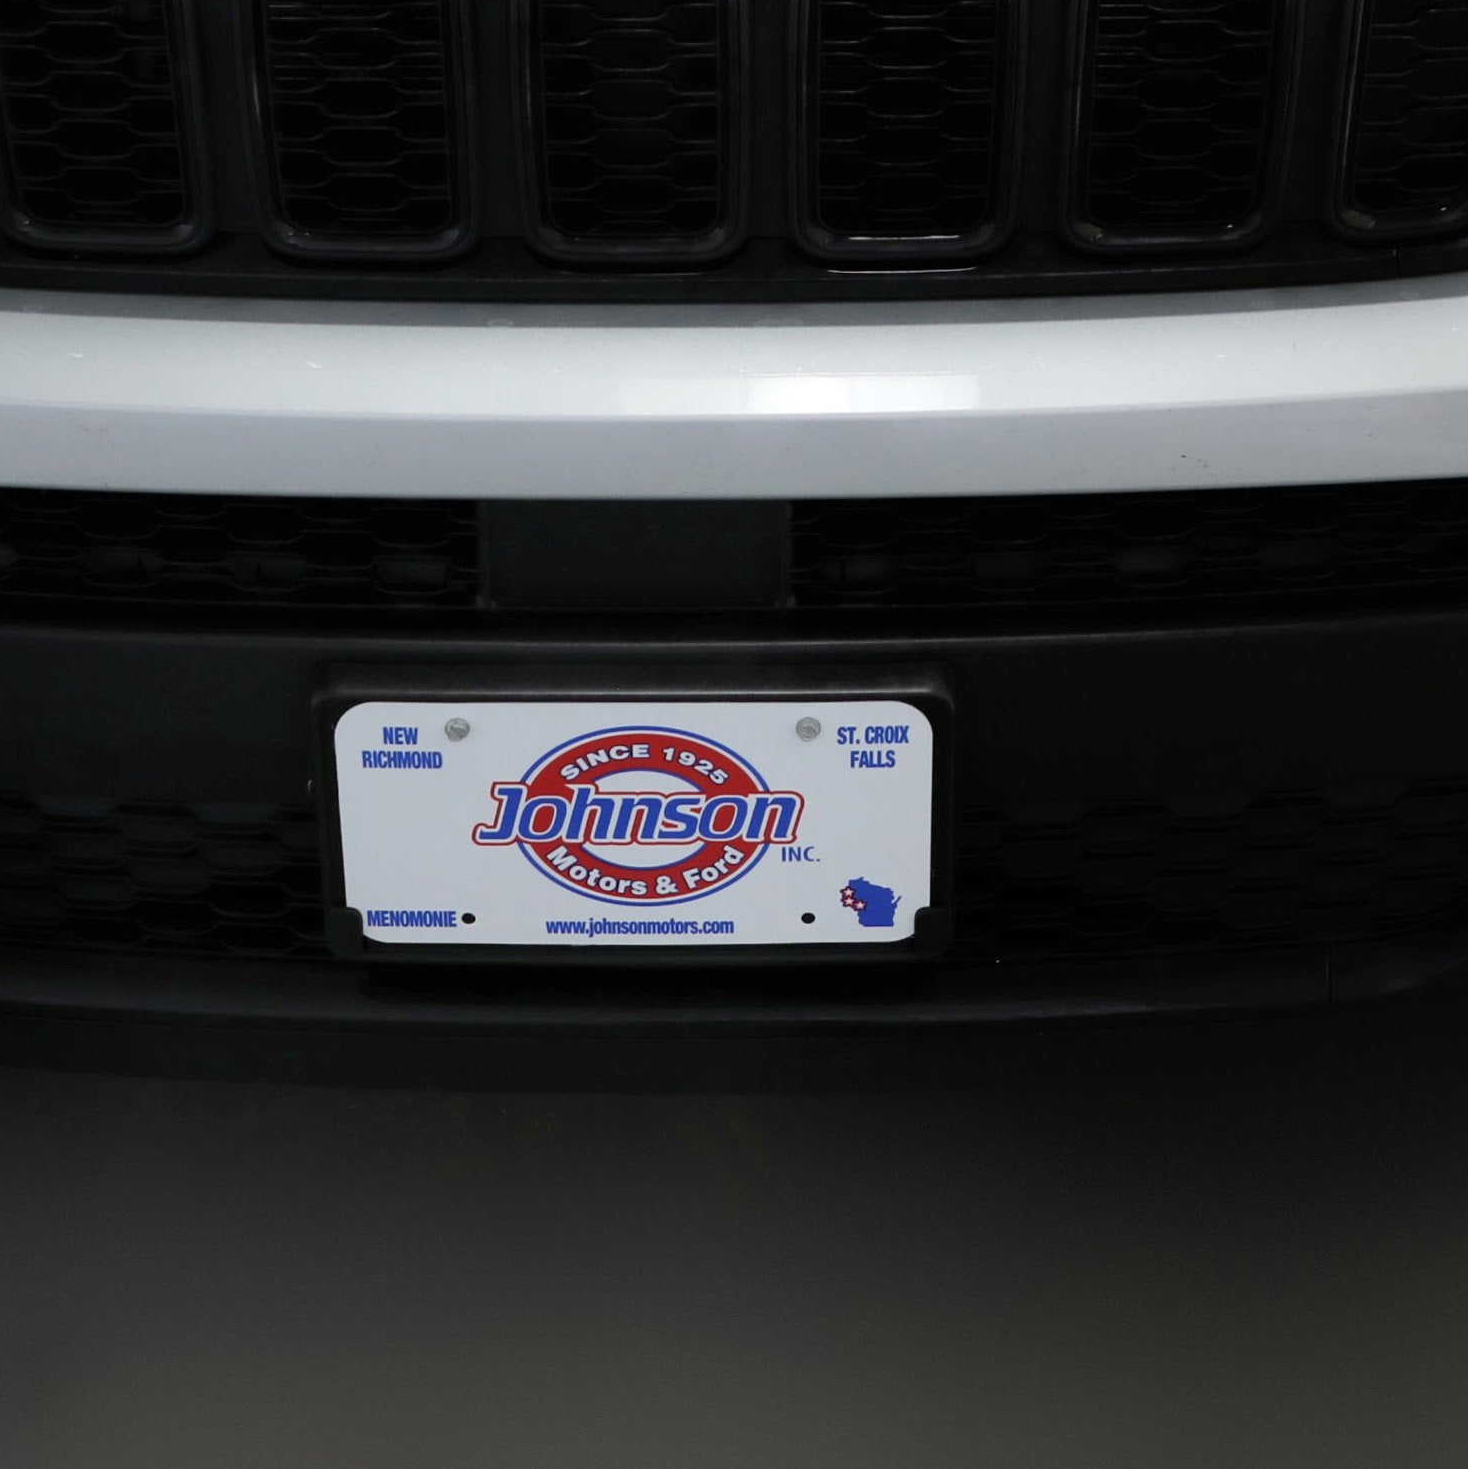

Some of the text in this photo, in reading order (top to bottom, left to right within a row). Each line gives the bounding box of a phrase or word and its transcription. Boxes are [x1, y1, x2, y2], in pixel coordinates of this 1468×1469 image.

[382, 727, 419, 745] NEW
[837, 725, 909, 744] ST. CROIX
[361, 750, 443, 769] RICHMOND
[560, 743, 729, 785] SINCE 1925
[850, 750, 896, 768] FALLS
[474, 782, 801, 843] Johnson
[781, 846, 821, 862] INC.
[546, 844, 745, 895] Motors & Ford
[367, 910, 457, 928] MENOMONIE
[546, 917, 735, 938] www.johnsonmotors.com
